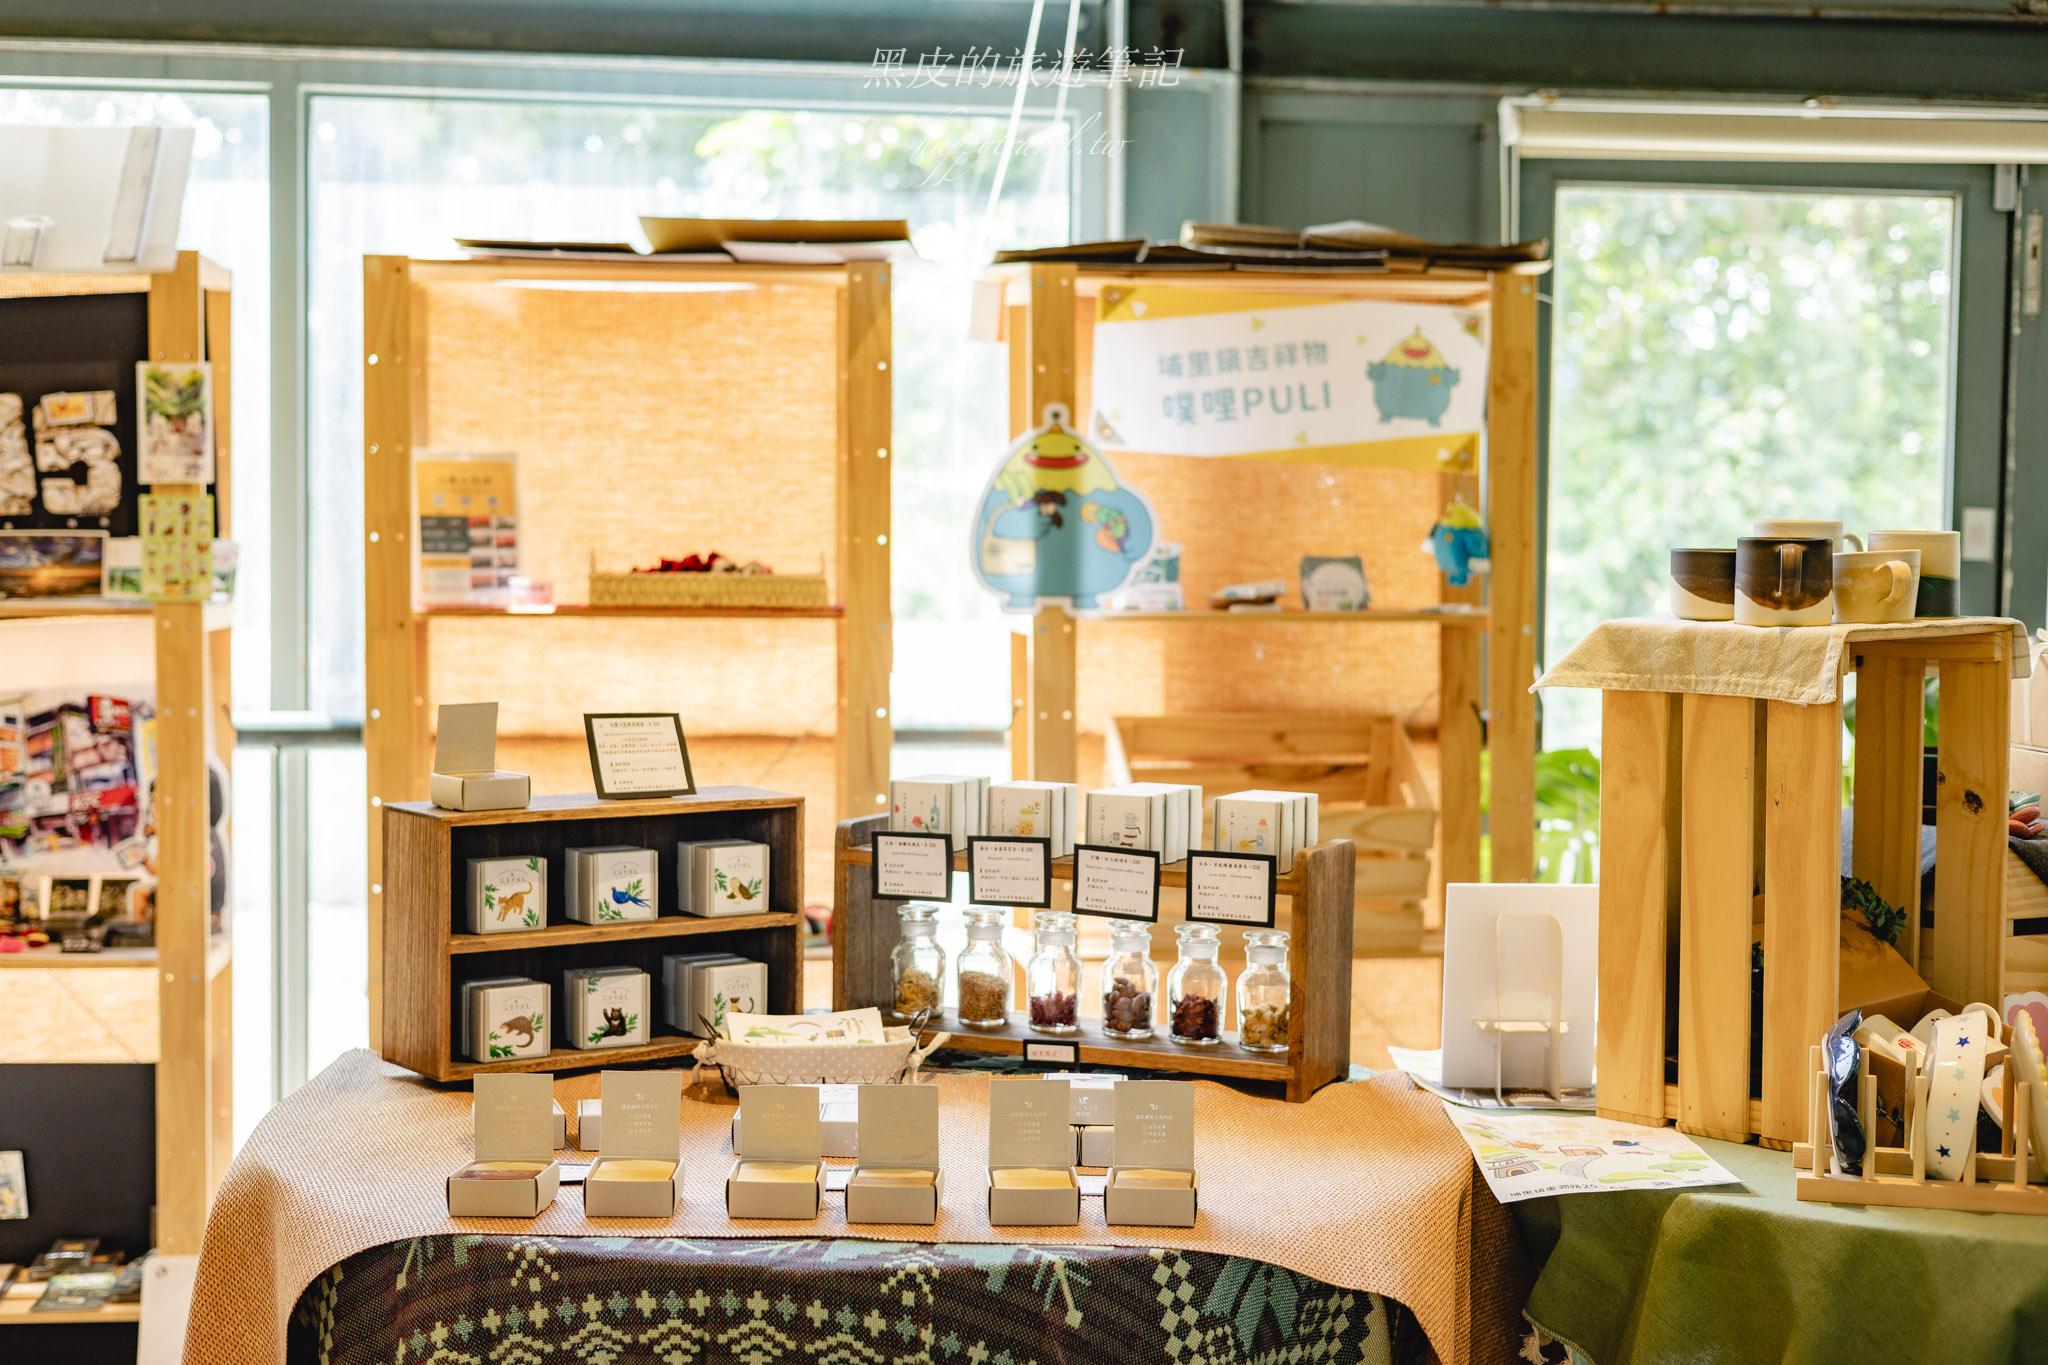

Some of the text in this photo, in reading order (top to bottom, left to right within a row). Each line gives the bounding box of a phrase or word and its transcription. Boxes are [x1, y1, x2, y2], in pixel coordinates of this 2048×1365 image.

[1158, 341, 1329, 379] 埔里鎮吉祥物
